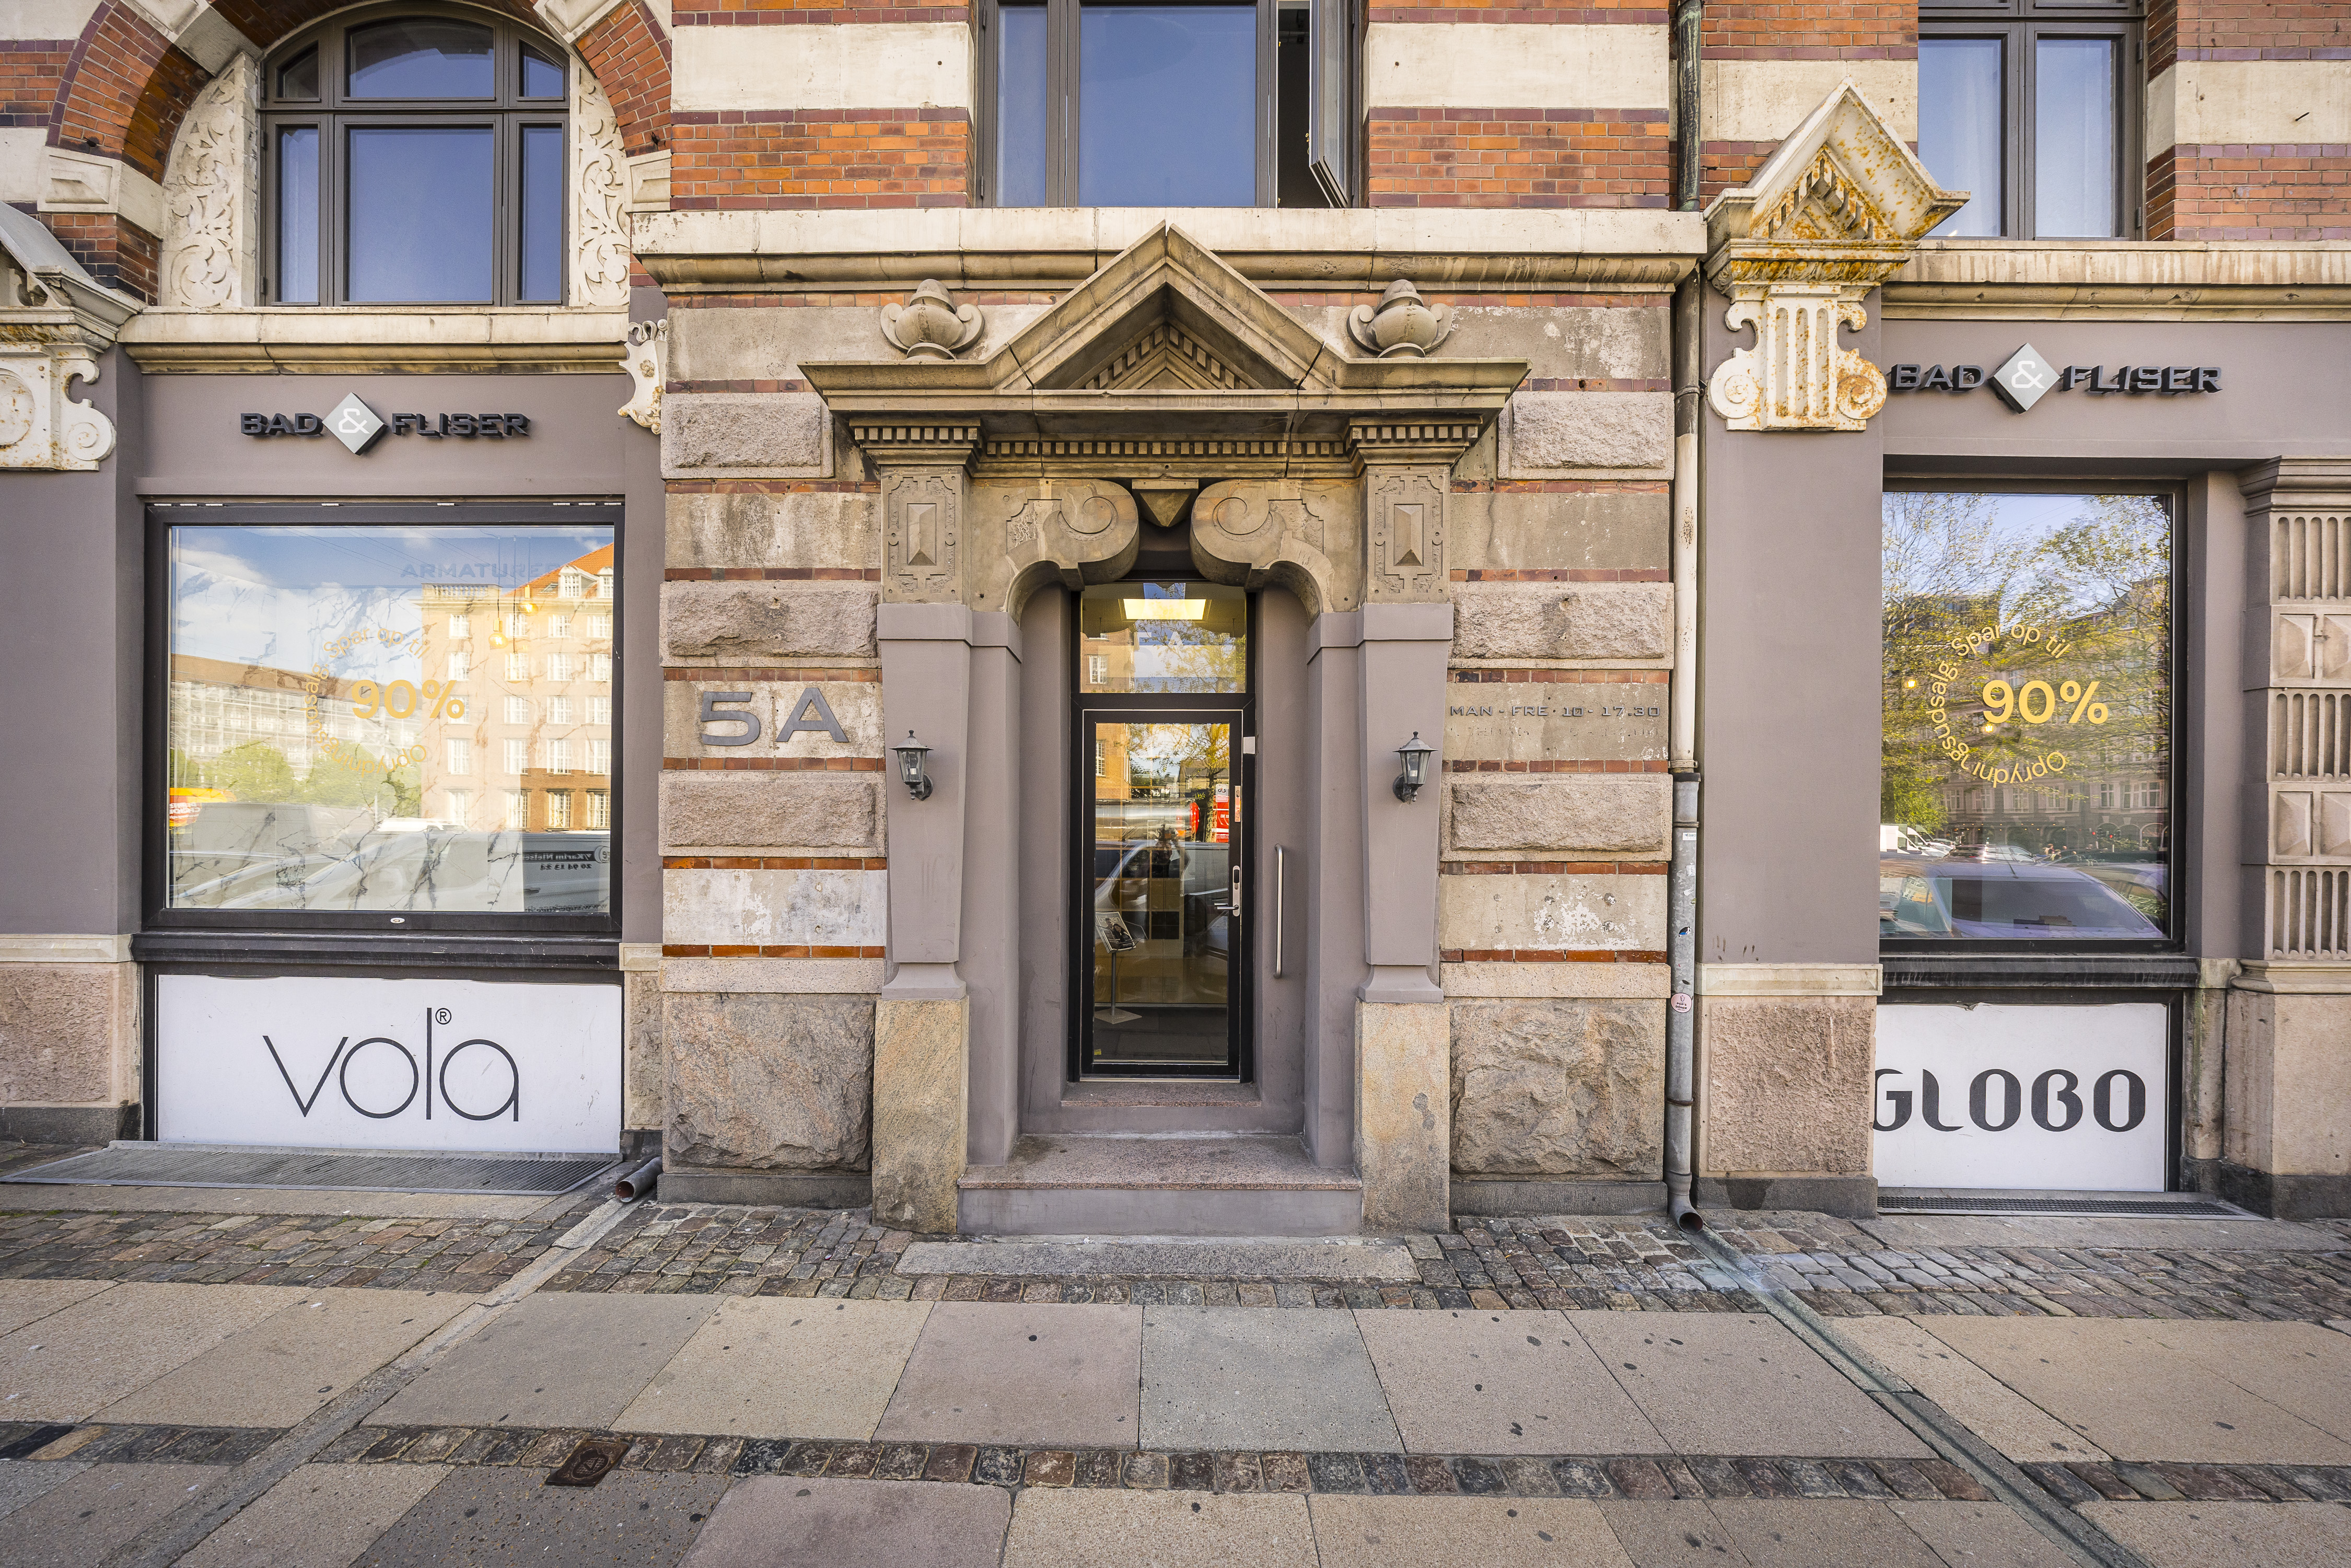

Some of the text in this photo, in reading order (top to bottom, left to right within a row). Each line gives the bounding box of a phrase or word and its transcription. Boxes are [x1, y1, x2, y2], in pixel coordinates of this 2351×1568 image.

[1891, 360, 2221, 392] BAD & FLISER
[241, 408, 529, 436] BAD & FLISER
[323, 628, 370, 658] Spar
[377, 628, 404, 648] op
[408, 637, 431, 659] til
[1951, 623, 2003, 657] Spar
[2010, 623, 2041, 646] op
[2045, 634, 2071, 659] til
[351, 679, 465, 719] 90%
[701, 687, 849, 746] 5A
[1450, 705, 1493, 716] MAN
[1511, 705, 1549, 716] FRE
[1562, 706, 1584, 717] 10
[1601, 706, 1660, 717] 17.30
[1982, 680, 2109, 725] 90%
[1872, 1068, 2146, 1132] GLOBO
